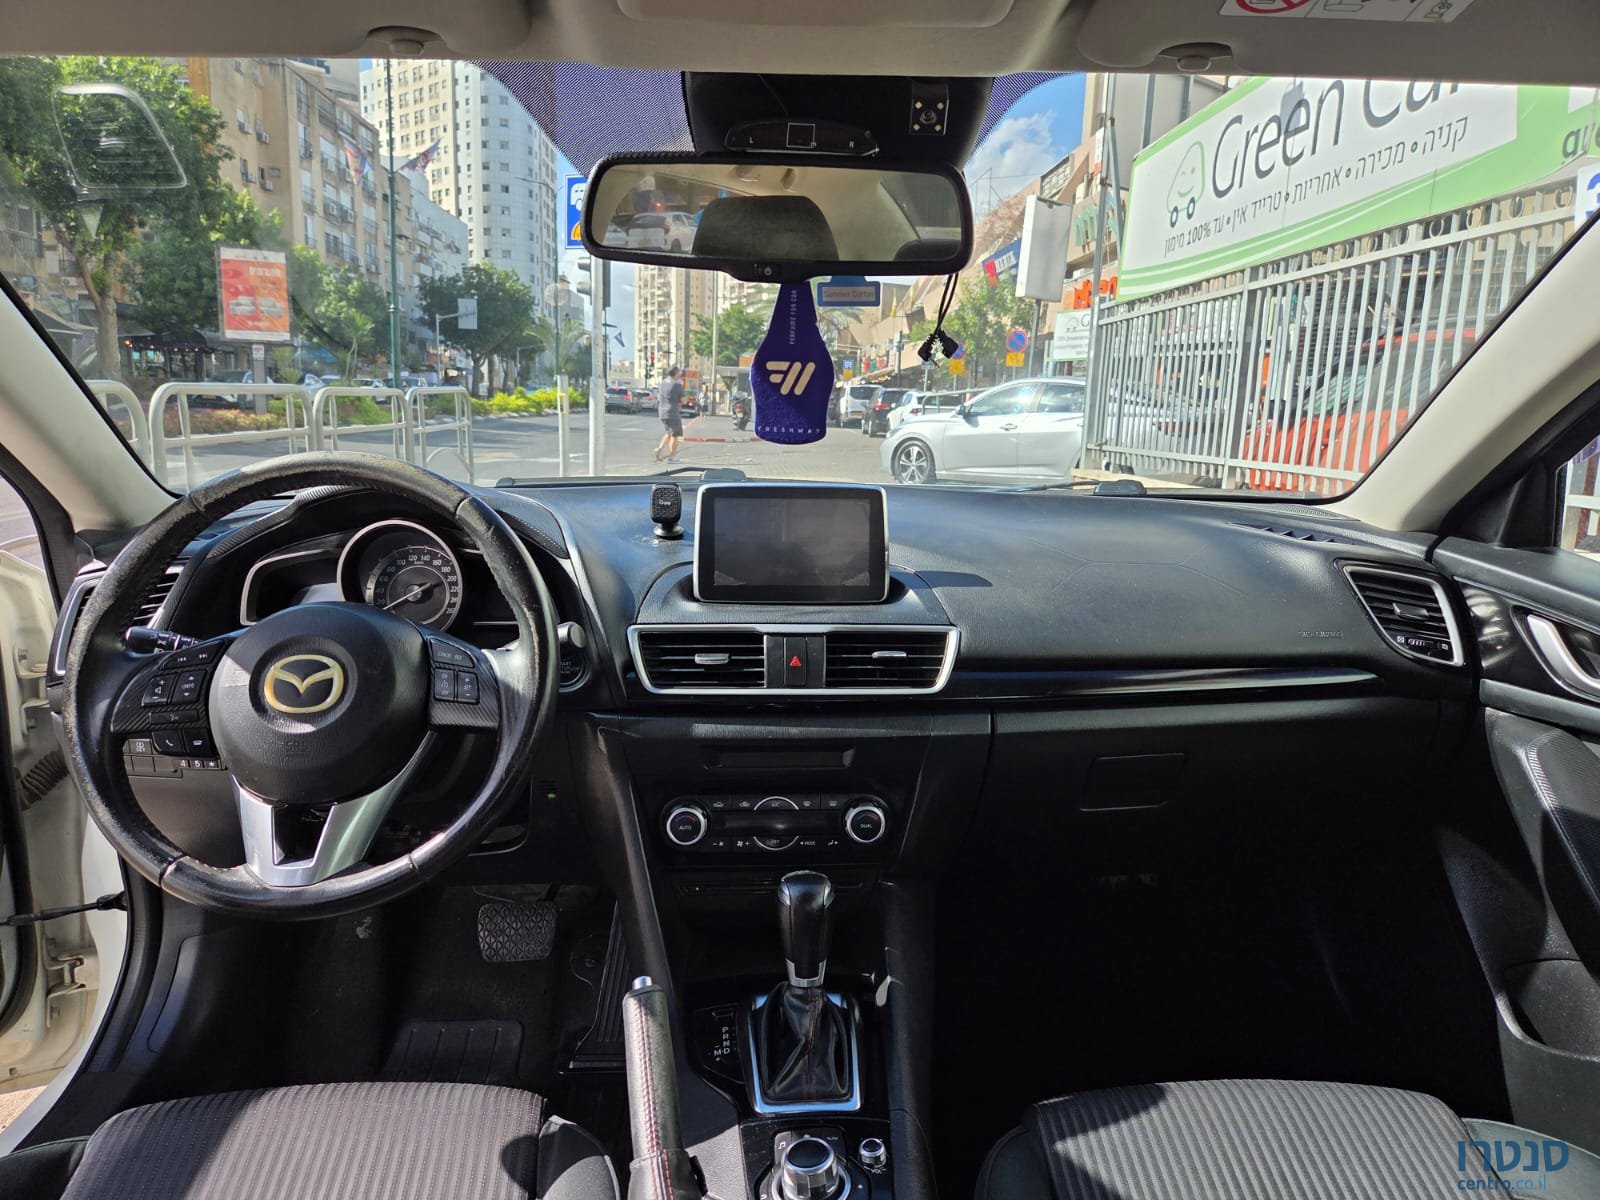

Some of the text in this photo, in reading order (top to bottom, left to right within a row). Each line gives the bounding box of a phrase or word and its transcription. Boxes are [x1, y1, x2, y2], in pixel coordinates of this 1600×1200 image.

[1164, 115, 1469, 259] קניה מכירה אחריות טרייד אין עד 100% מימון
[1212, 79, 1345, 199] Green
[194, 760, 201, 768] 5
